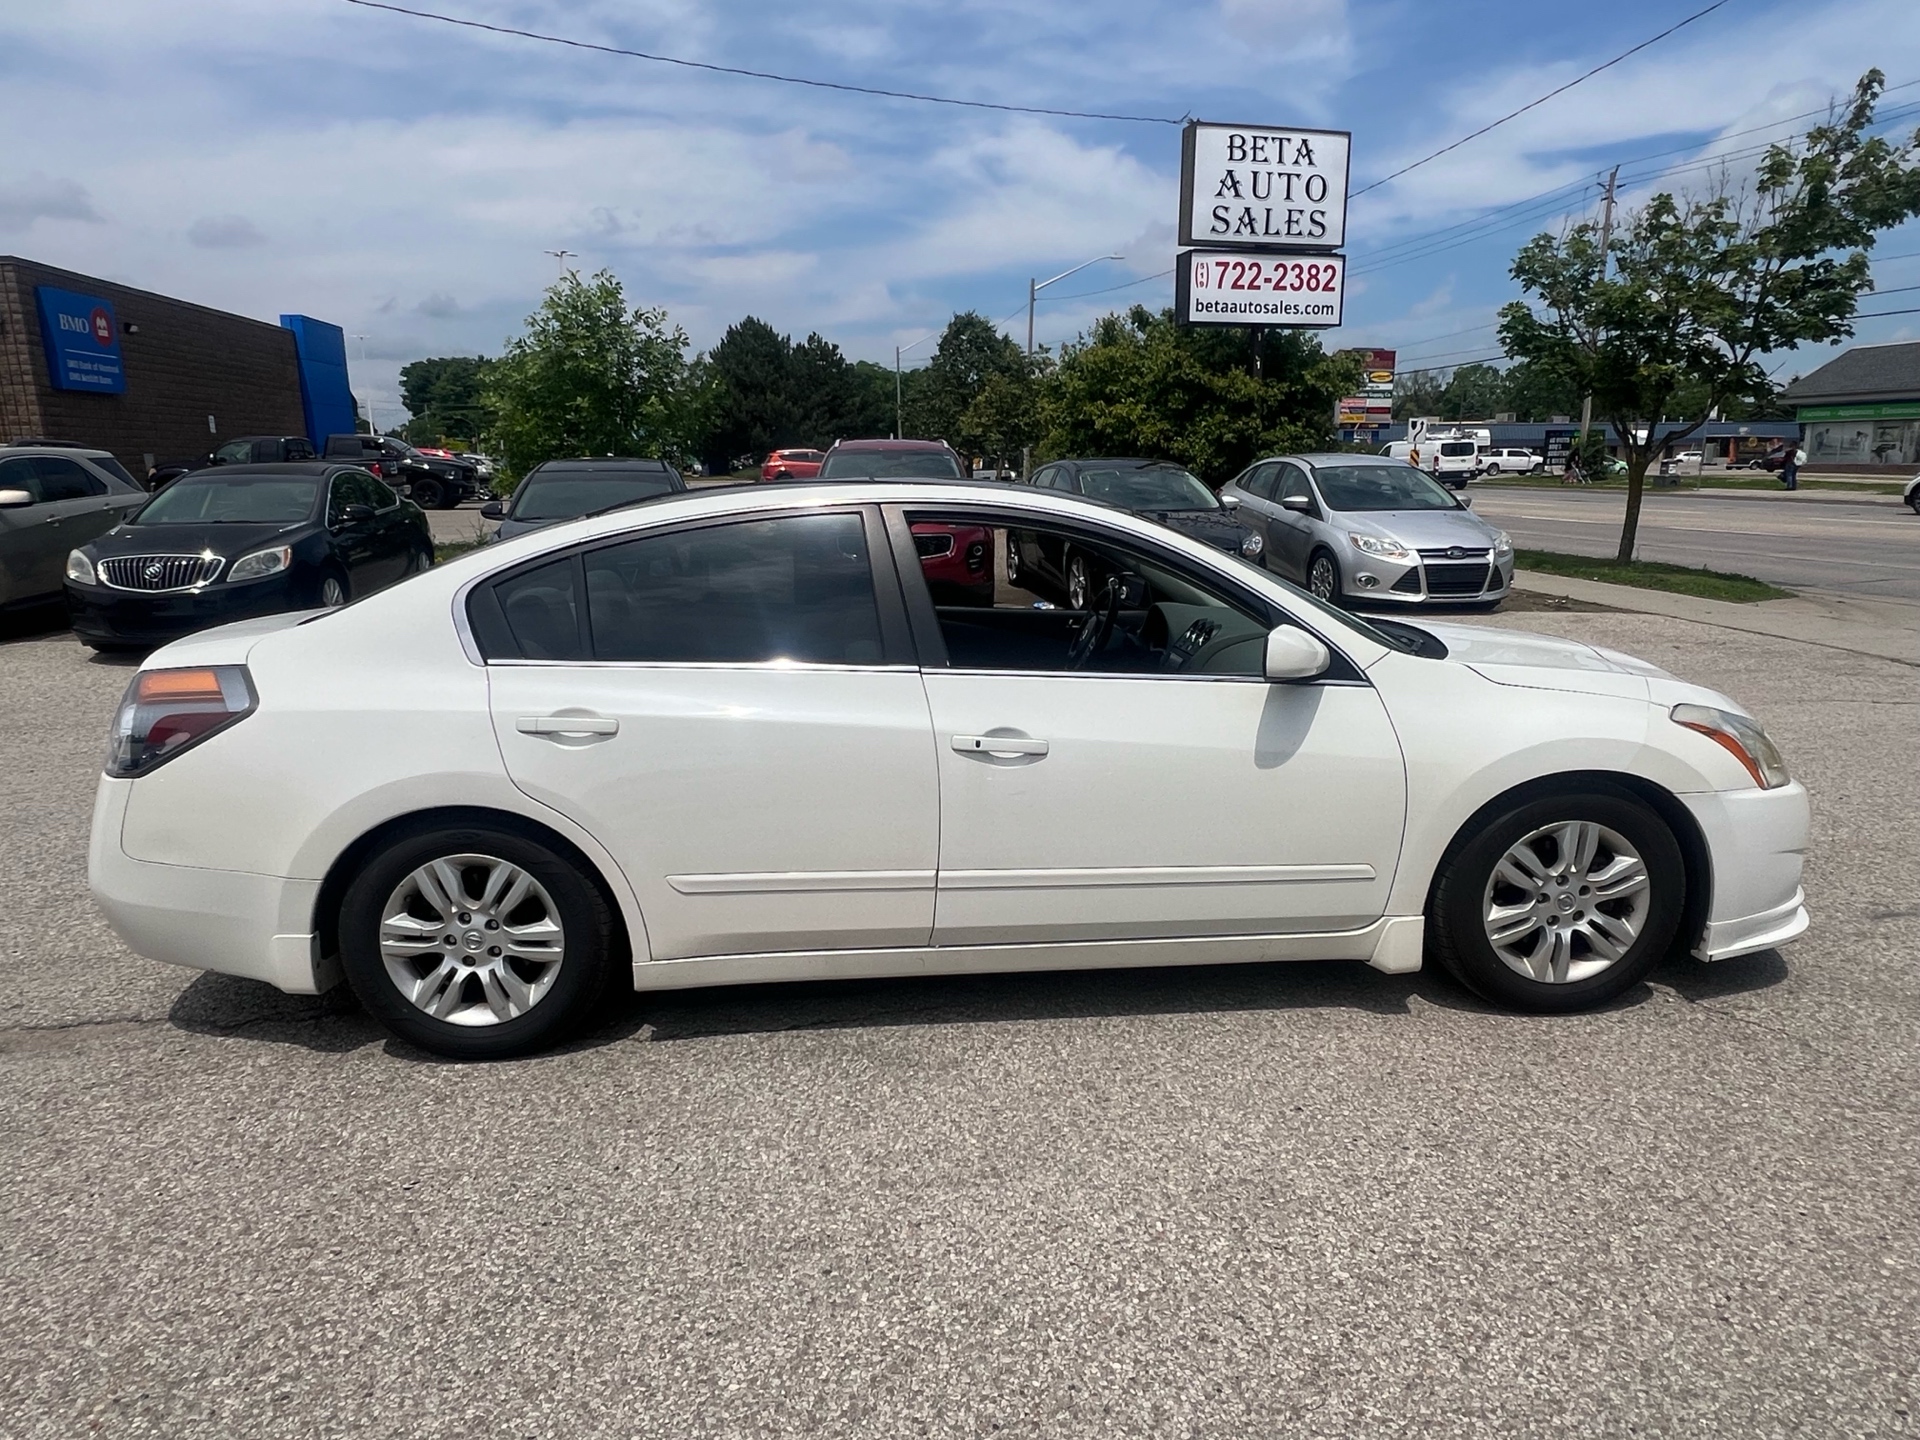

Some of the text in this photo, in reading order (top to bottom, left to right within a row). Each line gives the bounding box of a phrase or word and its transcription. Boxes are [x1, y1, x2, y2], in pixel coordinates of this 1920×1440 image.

[1226, 133, 1317, 167] BETA
[1214, 169, 1329, 203] AUTO
[1210, 205, 1327, 238] SALES
[1215, 261, 1337, 292] 722-2382
[1195, 298, 1334, 315] betaautosales.com
[58, 313, 90, 334] BMO
